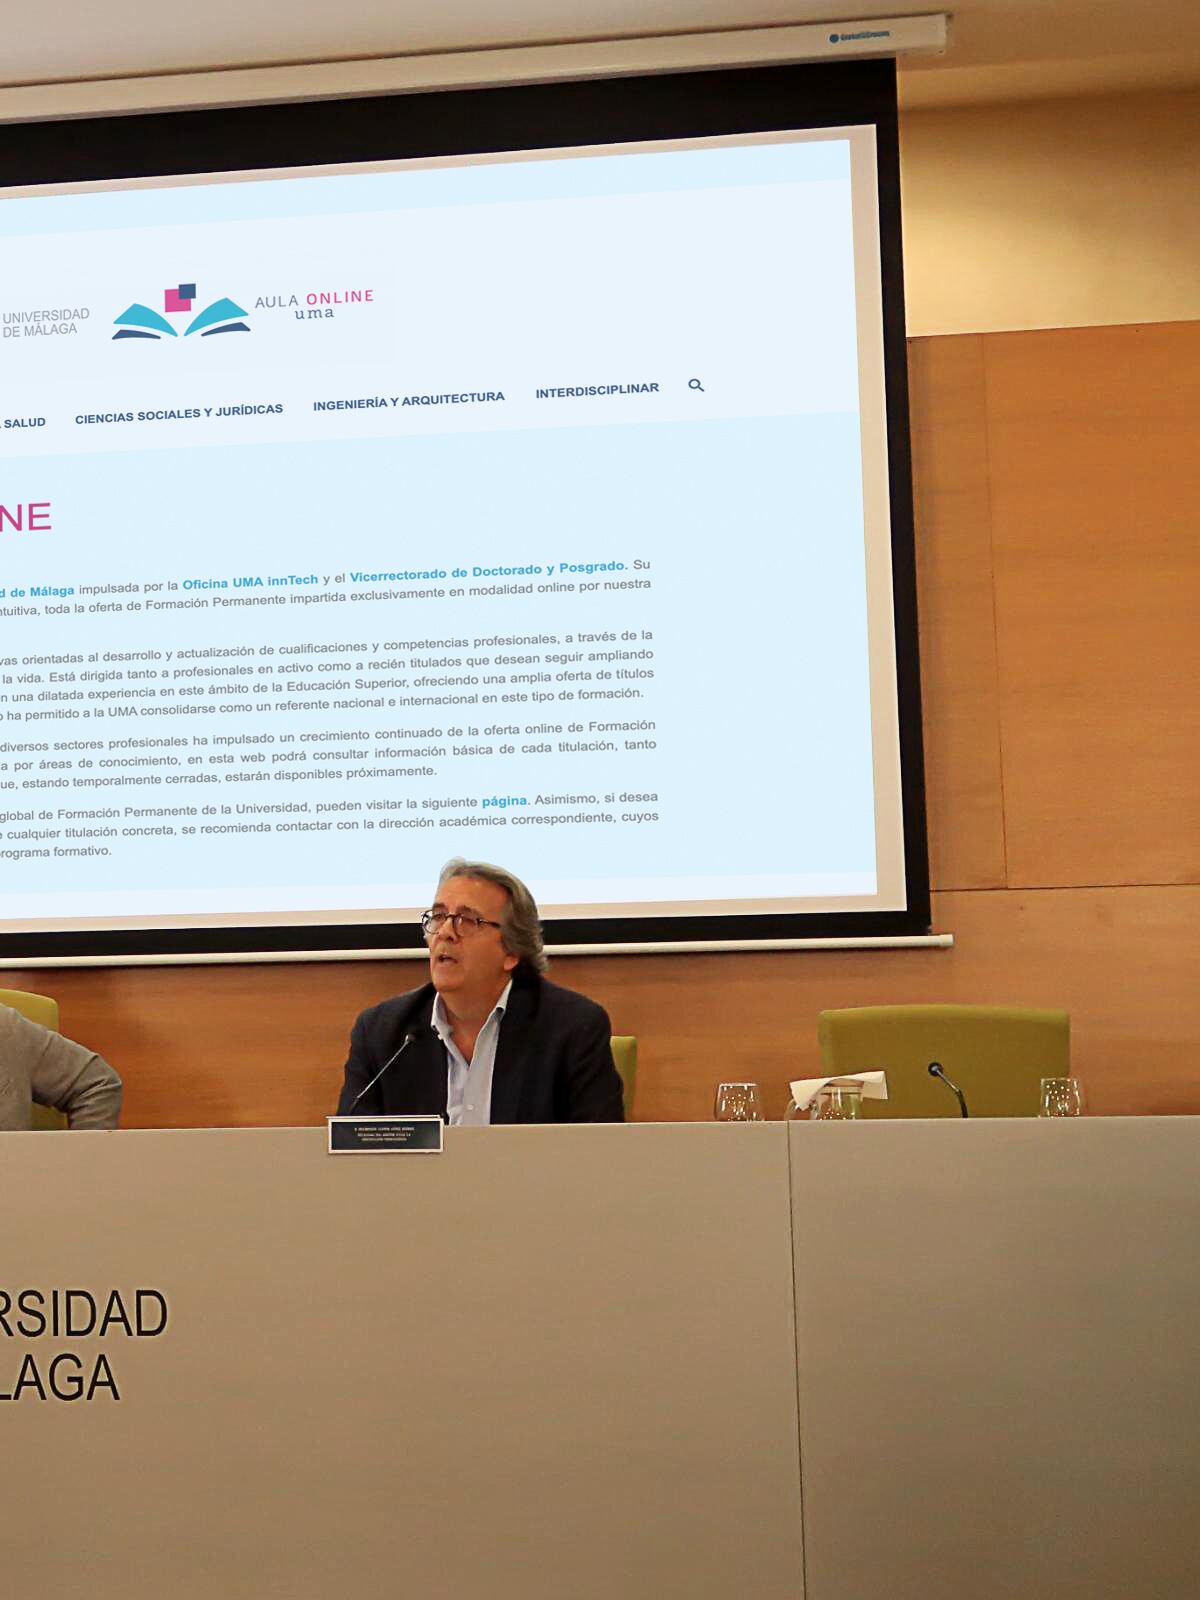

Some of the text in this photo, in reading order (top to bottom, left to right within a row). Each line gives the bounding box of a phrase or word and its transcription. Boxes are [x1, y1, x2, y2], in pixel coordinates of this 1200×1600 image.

[255, 289, 374, 309] AULA ONLINE
[2, 307, 90, 324] UNIVERSIDAD
[294, 308, 334, 320] uma
[3, 322, 78, 338] DE MÁLAGA
[535, 382, 660, 399] INTERDISCIPLINAR
[313, 391, 506, 412] INGENIERÍA Y ARQUITECTURA
[3, 417, 47, 429] SALUD
[74, 403, 284, 425] CIENCIAS SOCIALES Y JURÍDICAS
[9, 587, 26, 598] de
[29, 585, 75, 599] Málaga
[79, 582, 140, 597] impulsada
[143, 583, 164, 595] por
[167, 580, 179, 591] la
[181, 578, 229, 591] Oficina
[232, 576, 264, 588] UMA
[267, 574, 319, 587] innTech
[322, 575, 331, 586] y
[334, 572, 346, 584] el
[349, 568, 448, 583] Vicerrectorado
[451, 567, 468, 579] de
[472, 564, 543, 578] Doctorado
[546, 565, 555, 577] y
[559, 560, 629, 575] Posgrado.
[633, 559, 651, 570] Su
[44, 603, 71, 615] toda
[74, 603, 85, 614] la
[88, 601, 123, 613] oferta
[126, 600, 142, 611] de
[145, 597, 209, 611] Formación
[212, 594, 287, 607] Permanente
[290, 591, 347, 606] impartida
[350, 587, 446, 602] exclusivamente
[449, 588, 465, 597] en
[468, 583, 534, 597] modalidad
[537, 581, 575, 593] online
[579, 582, 601, 594] por
[603, 579, 652, 590] nuestra
[21, 653, 84, 666] orientadas
[87, 652, 99, 663] al
[102, 649, 162, 662] desarrollo
[165, 651, 173, 662] y
[176, 646, 255, 660] actualización
[258, 645, 275, 656] de
[278, 642, 368, 655] cualificaciones
[371, 642, 380, 654] y
[383, 637, 469, 652] competencias
[473, 634, 561, 649] profesionales,
[564, 634, 573, 644] a
[577, 631, 617, 643] través
[620, 630, 638, 641] de
[641, 629, 653, 640] la
[0, 741, 50, 753] diversos
[53, 740, 104, 751] sectores
[108, 736, 189, 752] profesionales
[192, 735, 209, 746] ha
[212, 733, 275, 747] impulsado
[279, 734, 295, 743] un
[299, 729, 370, 743] crecimiento
[374, 727, 443, 740] continuado
[447, 726, 464, 737] de
[467, 725, 479, 737] la
[483, 724, 520, 736] oferta
[524, 723, 563, 735] online
[567, 722, 584, 733] de
[588, 719, 656, 732] Formación
[38, 809, 54, 820] de
[57, 807, 121, 820] Formación
[124, 805, 198, 818] Permanente
[201, 804, 217, 816] de
[220, 804, 232, 815] la
[235, 801, 312, 815] Universidad,
[315, 800, 362, 815] pueden
[365, 799, 403, 810] visitar
[406, 798, 418, 809] la
[421, 797, 478, 811] siguiente
[481, 795, 531, 809] página.
[534, 793, 600, 806] Asimismo,
[603, 792, 615, 804] si
[618, 791, 659, 803] desea
